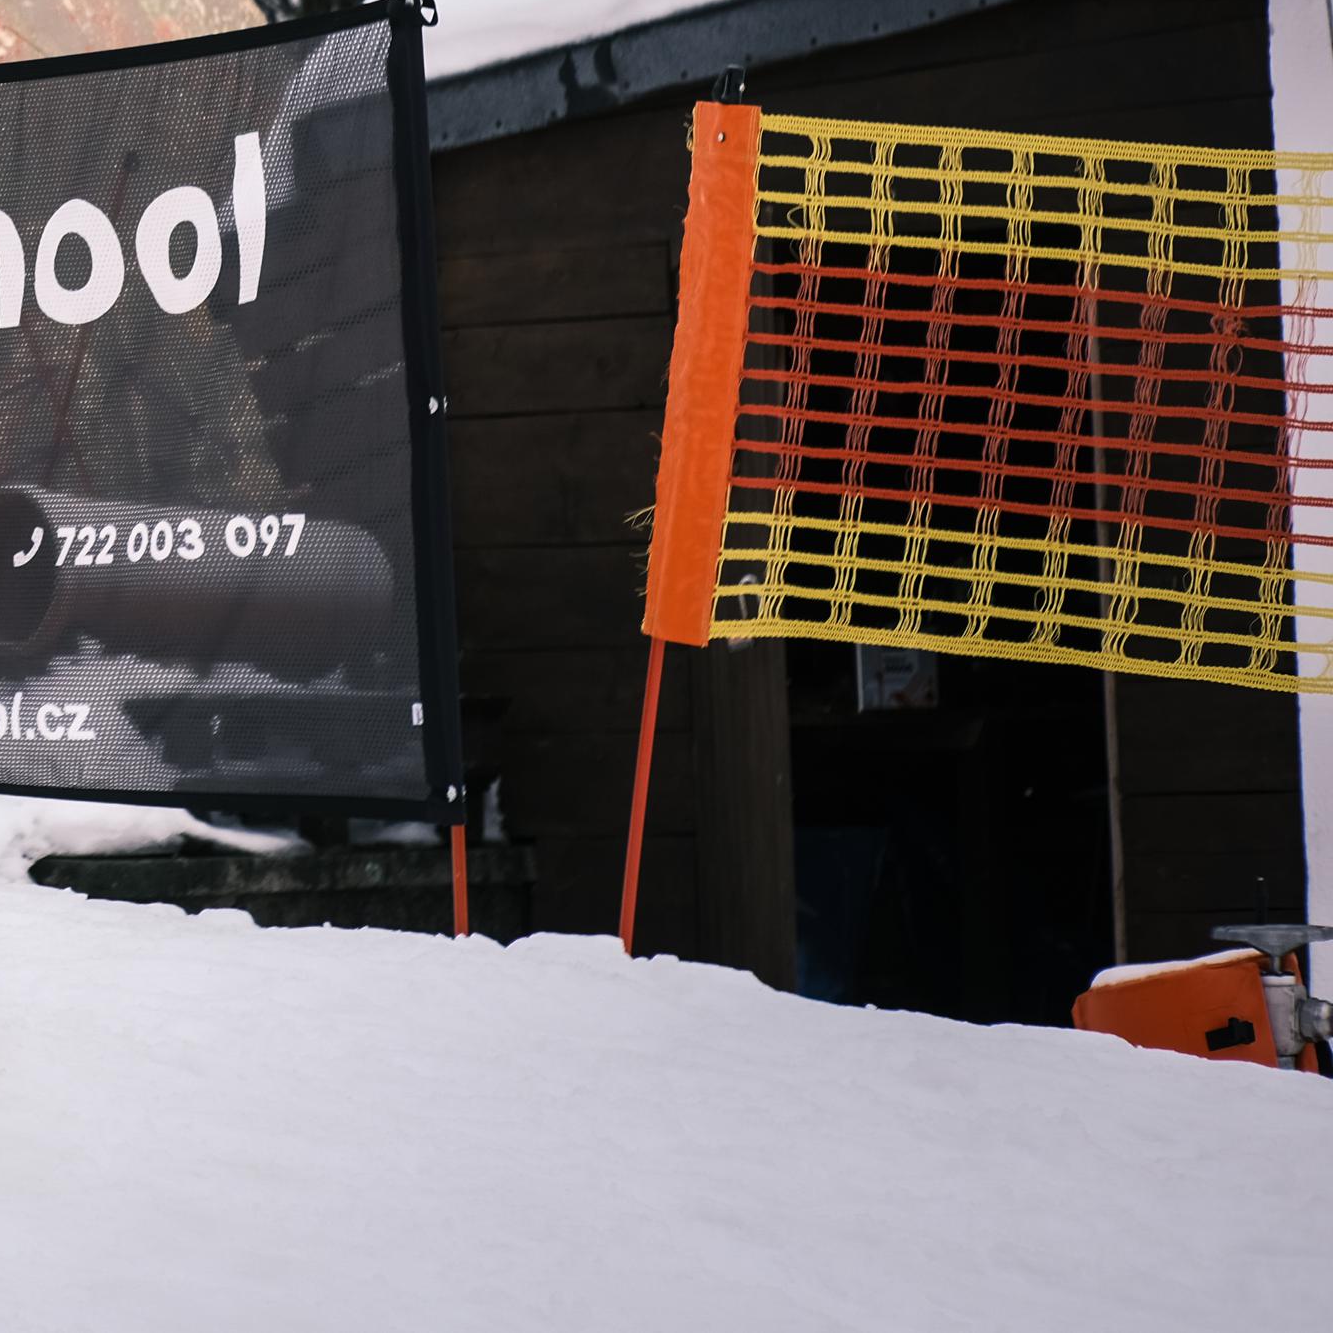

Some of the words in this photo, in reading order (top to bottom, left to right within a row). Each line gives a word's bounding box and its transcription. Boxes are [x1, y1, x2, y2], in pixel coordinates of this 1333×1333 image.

[54, 524, 117, 567] 722
[127, 520, 206, 563] 003
[224, 513, 306, 558] 097
